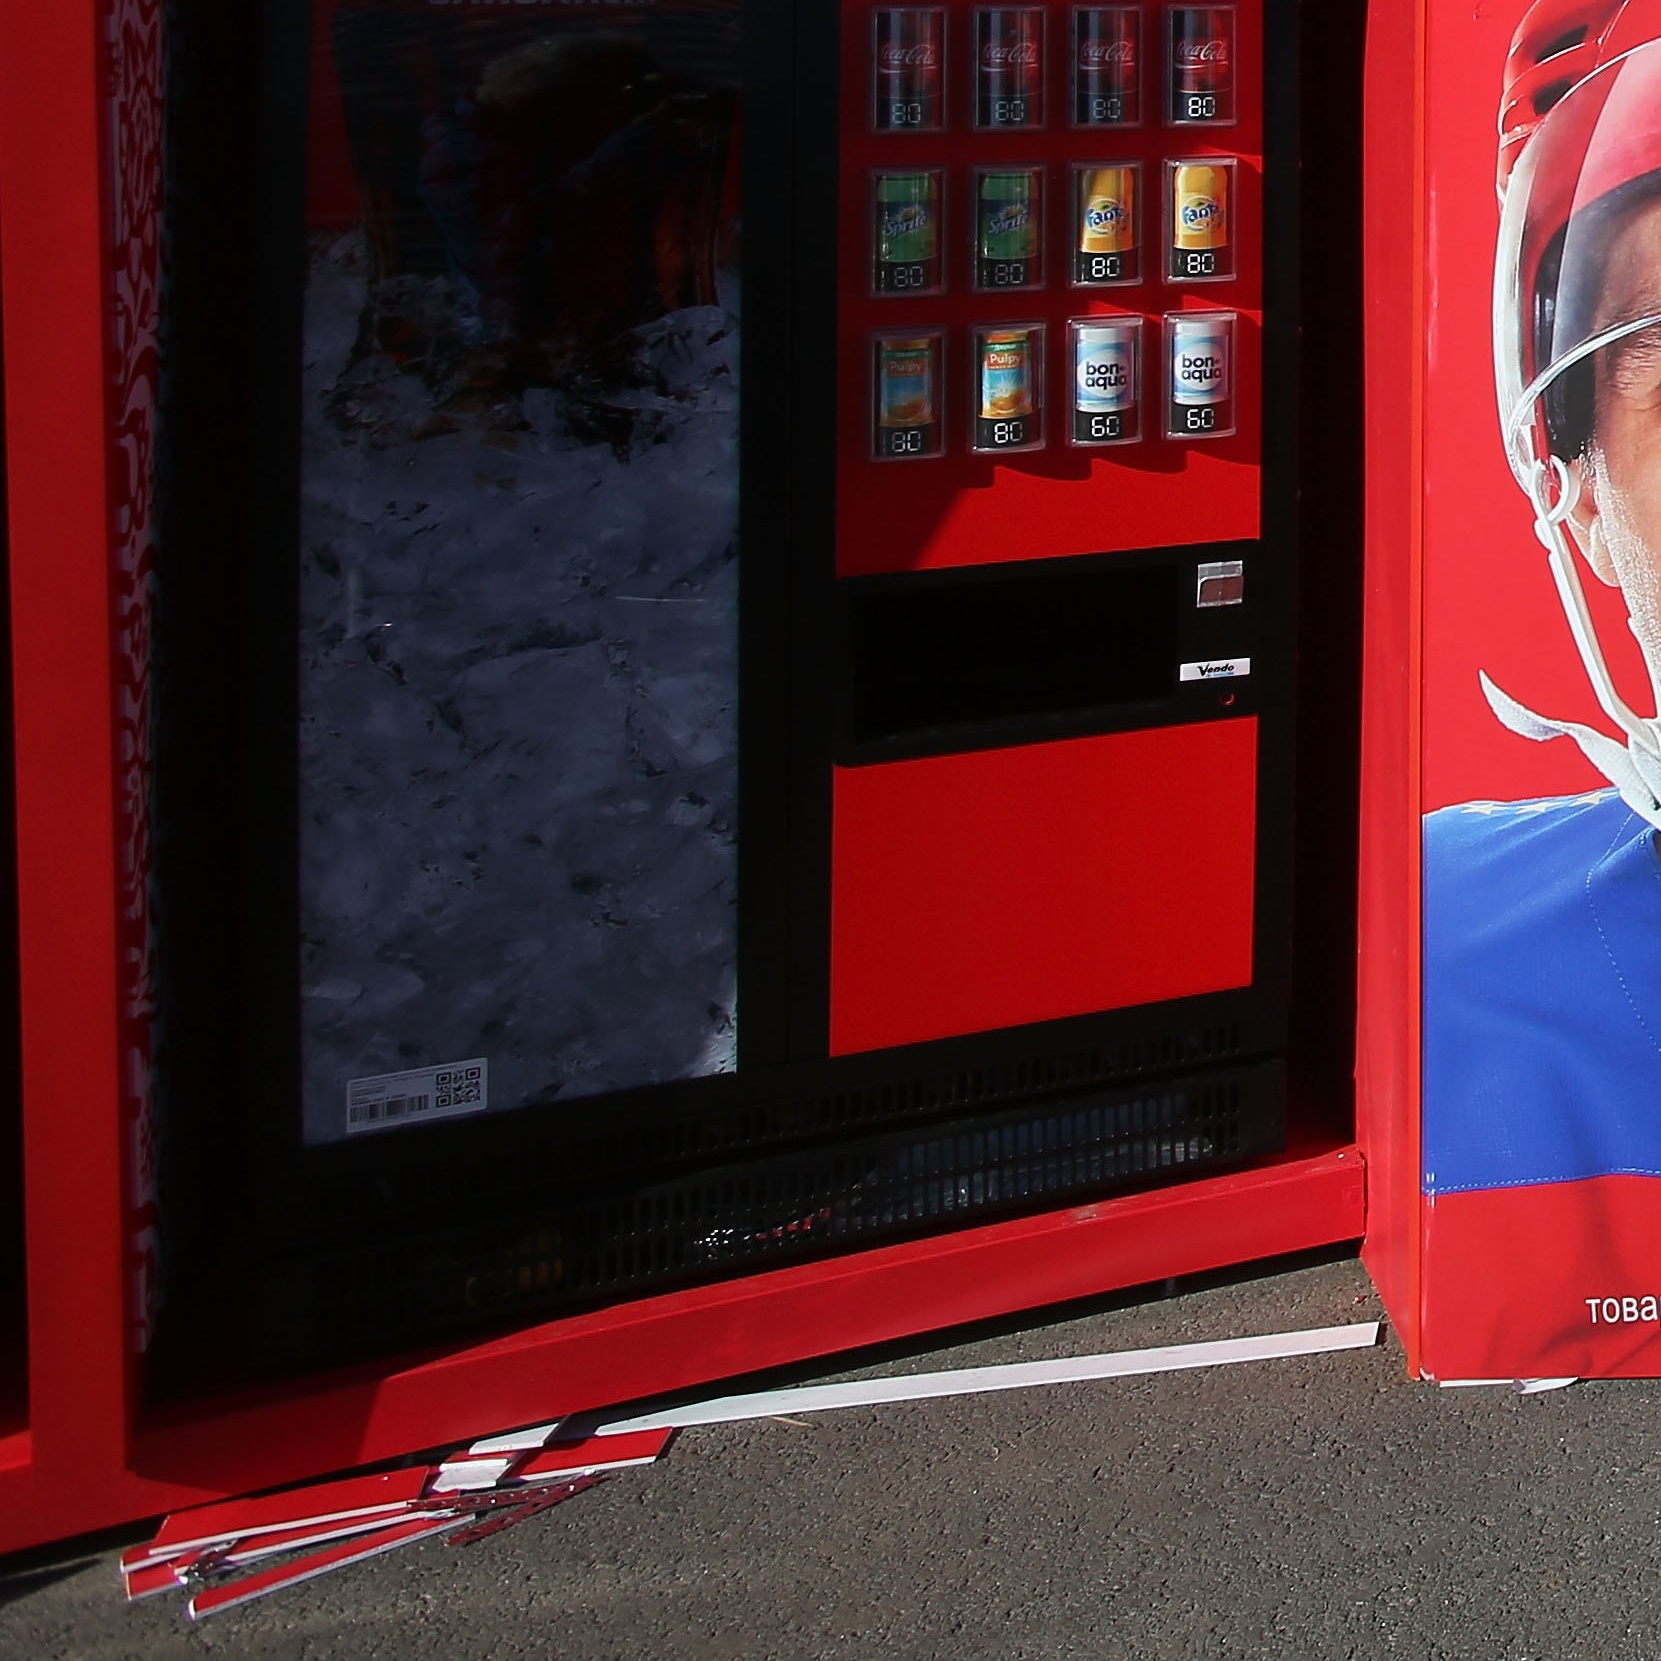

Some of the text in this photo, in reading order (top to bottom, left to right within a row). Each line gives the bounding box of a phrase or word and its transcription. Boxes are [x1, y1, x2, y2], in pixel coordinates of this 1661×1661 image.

[892, 103, 921, 124] 80
[996, 101, 1024, 121] 80
[1094, 99, 1120, 119] 80
[1188, 97, 1215, 117] 80
[995, 263, 1024, 284] 80
[1091, 257, 1120, 278] 80
[1187, 253, 1215, 274] 80
[894, 266, 923, 287] 80
[889, 360, 921, 373] Pulpy
[989, 353, 1021, 366] Pulpy
[1085, 374, 1127, 390] aqua
[1181, 367, 1222, 383] aqua
[1091, 416, 1119, 437] 60
[1187, 409, 1214, 429] 60
[892, 431, 921, 452] 80
[994, 422, 1023, 444] 80
[1197, 663, 1235, 677] Vendo
